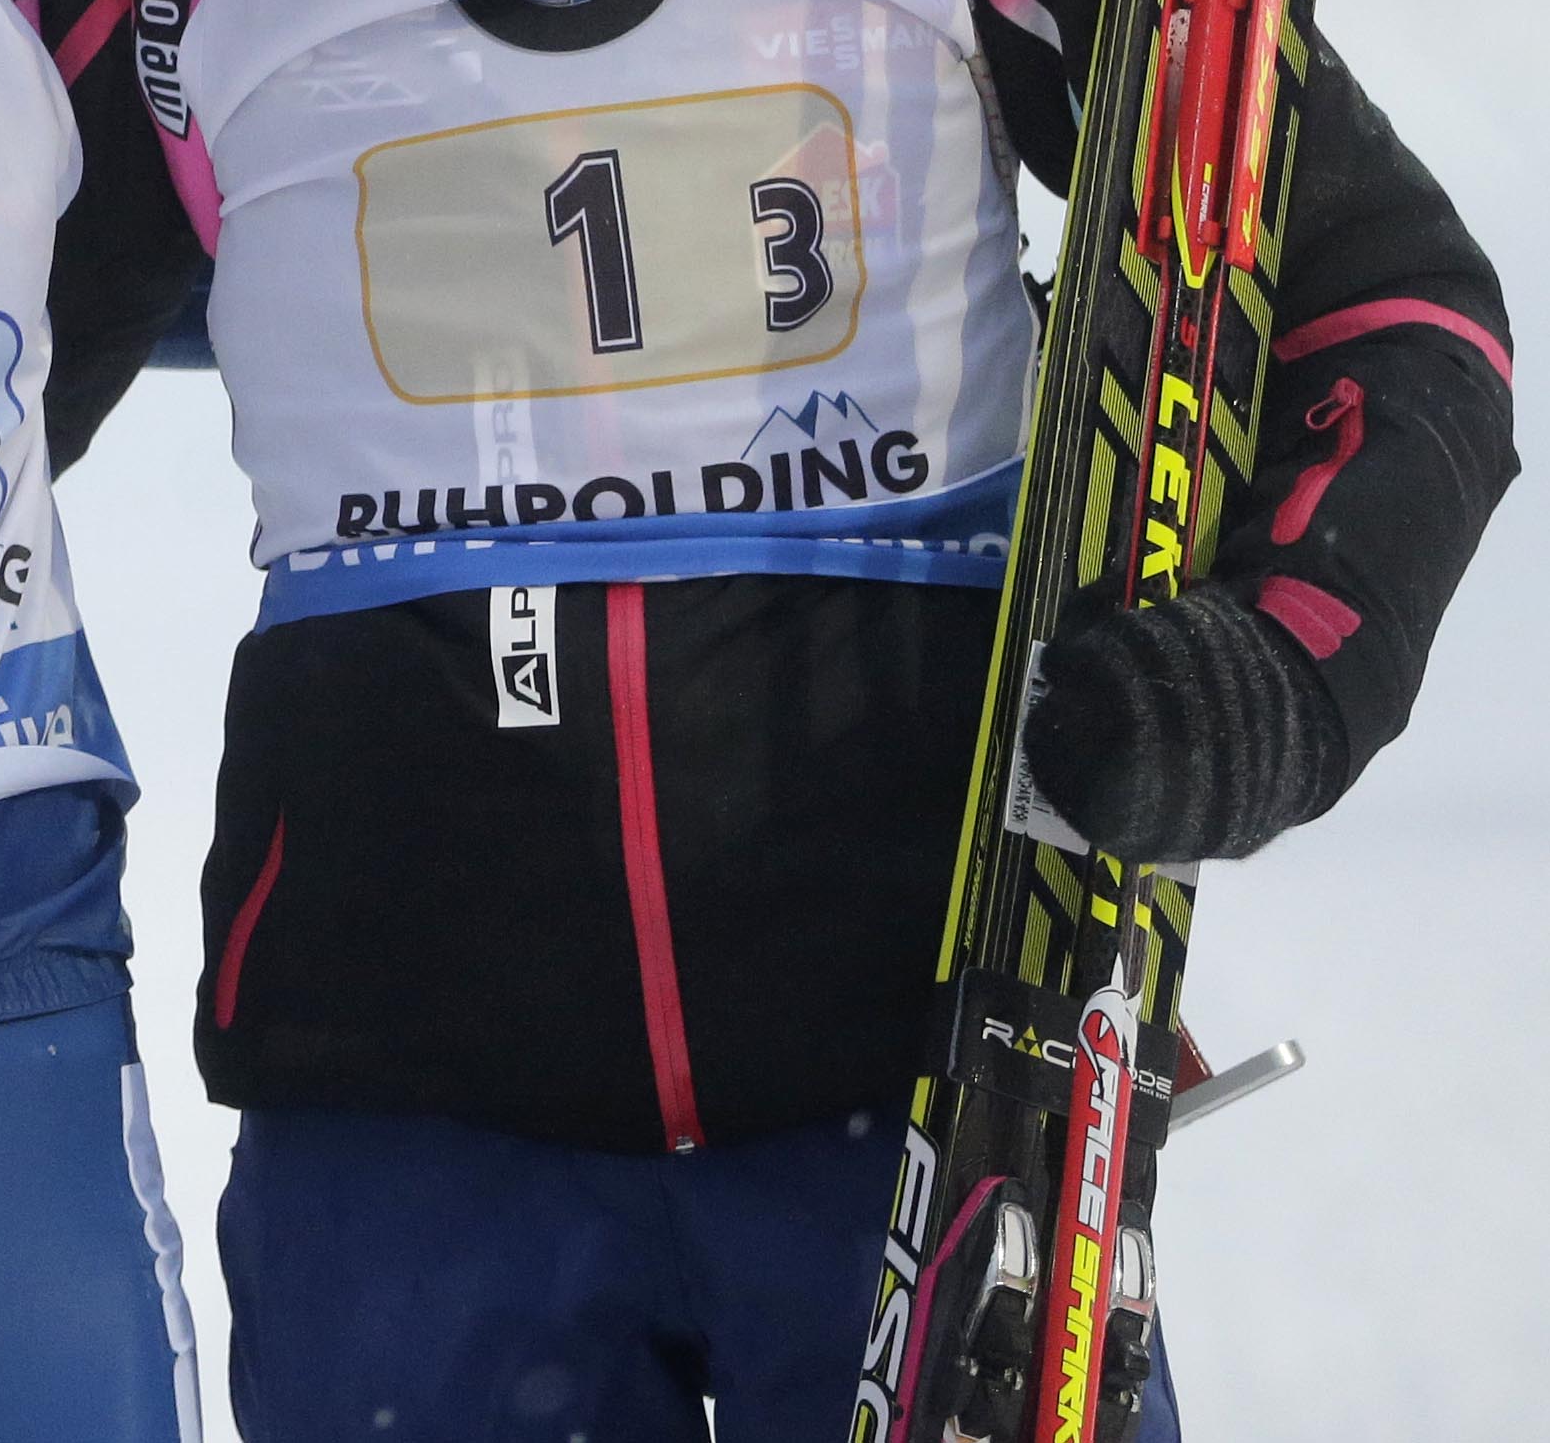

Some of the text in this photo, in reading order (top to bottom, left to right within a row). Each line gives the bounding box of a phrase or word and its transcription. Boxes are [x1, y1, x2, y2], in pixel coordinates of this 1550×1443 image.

[544, 147, 834, 356] 1 3
[1078, 1053, 1119, 1235] RACE
